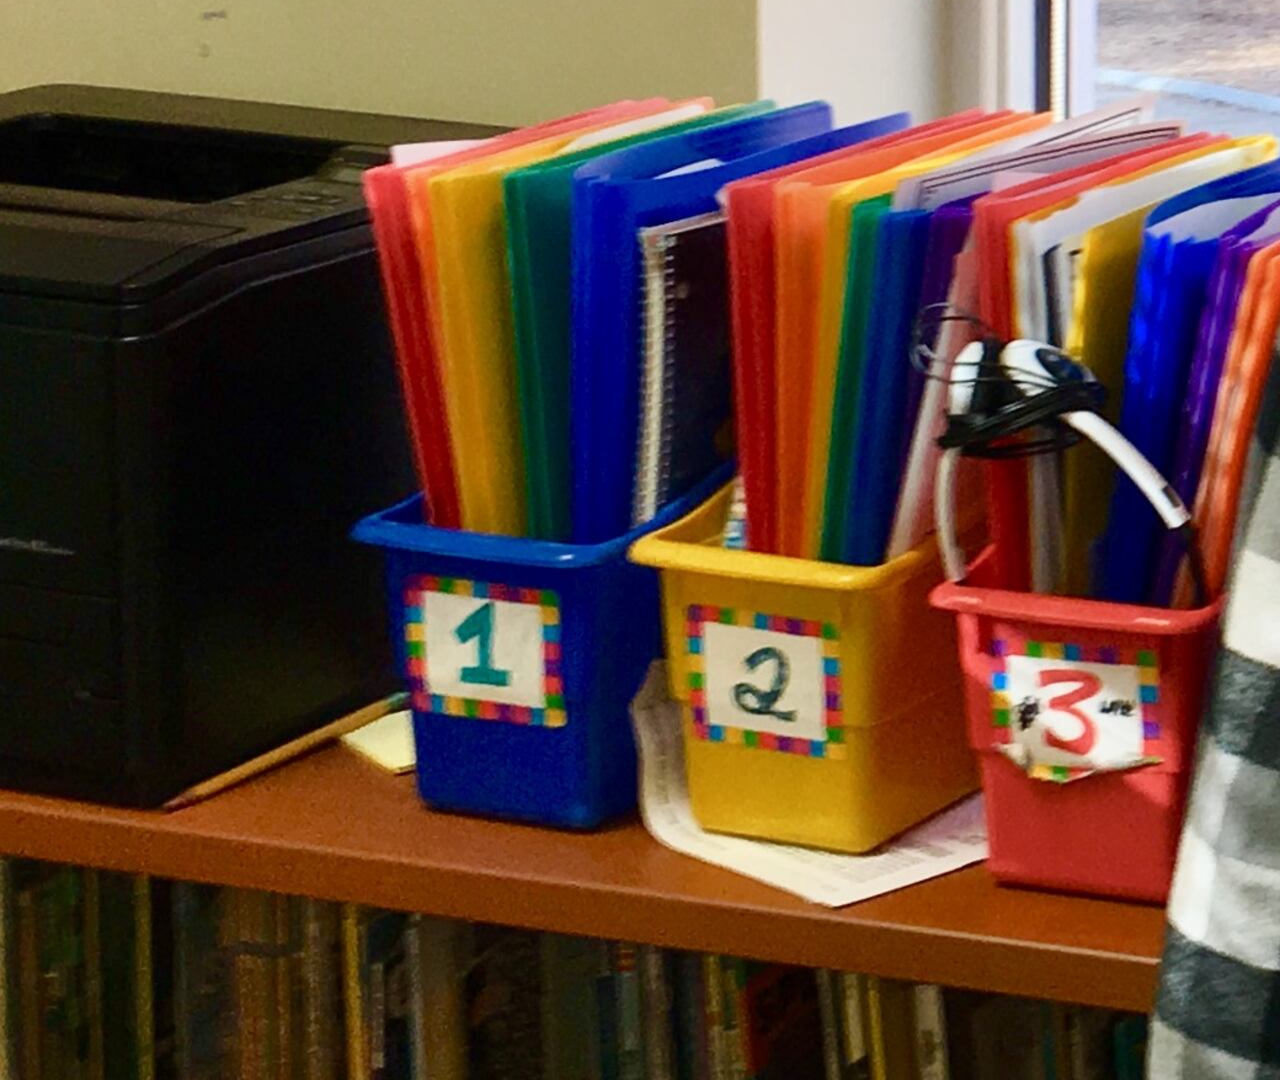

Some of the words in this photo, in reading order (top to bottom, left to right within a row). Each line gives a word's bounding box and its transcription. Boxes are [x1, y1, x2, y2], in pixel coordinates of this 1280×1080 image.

[455, 600, 511, 687] 1
[731, 646, 797, 722] 2
[1039, 669, 1103, 756] 3
